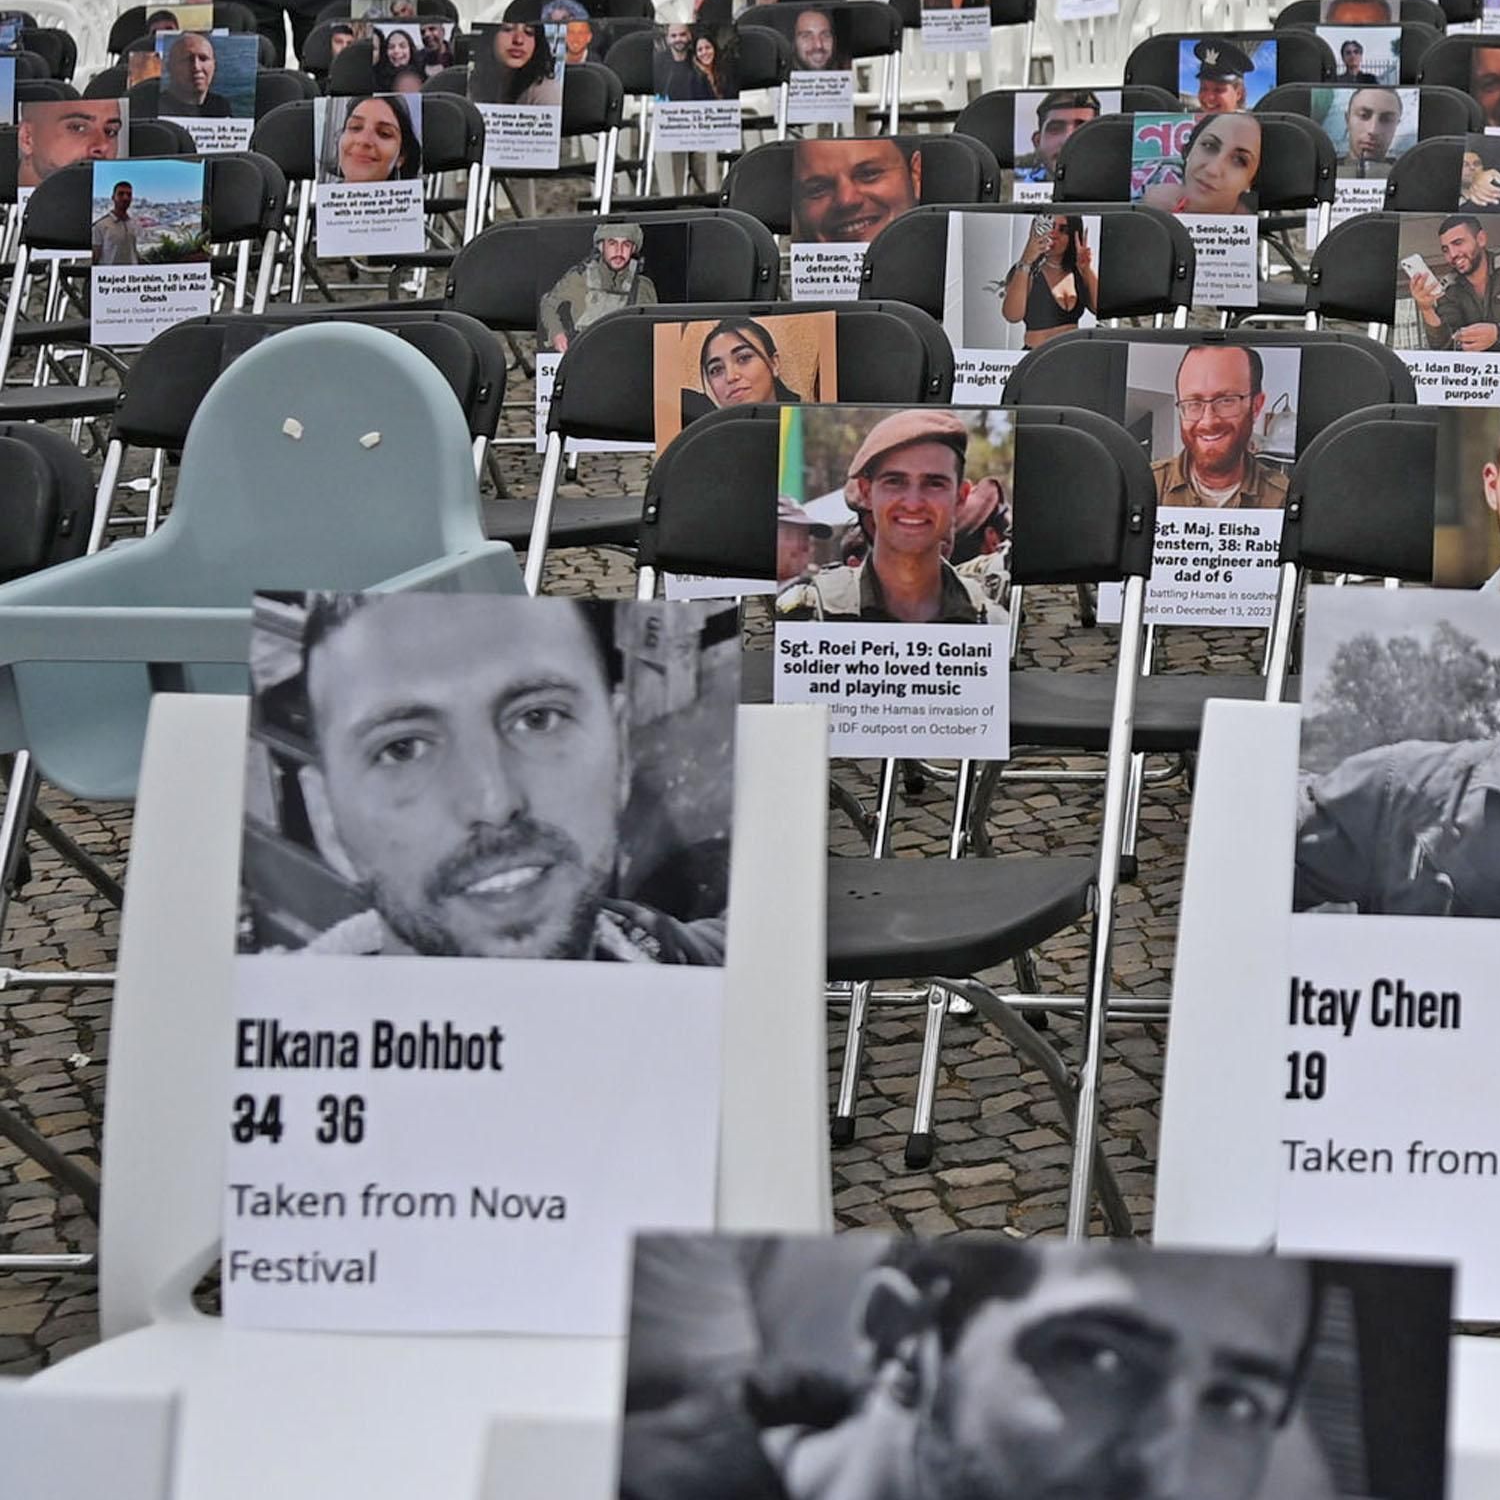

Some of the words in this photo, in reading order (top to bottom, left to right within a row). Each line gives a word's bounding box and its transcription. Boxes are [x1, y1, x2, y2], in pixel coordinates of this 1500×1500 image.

[1196, 224, 1230, 235] Senior,
[1218, 236, 1251, 247] helped
[793, 253, 815, 262] Aviv
[1206, 248, 1227, 256] rave
[806, 264, 852, 273] defender,
[98, 274, 126, 285] Majed
[128, 273, 165, 284] Ibrahim,
[183, 272, 206, 281] Killed
[795, 275, 830, 284] rockers
[833, 275, 840, 283] &
[99, 285, 109, 295] by
[112, 284, 141, 293] rocket
[144, 284, 162, 292] that
[163, 283, 176, 292] fell
[179, 283, 187, 291] in
[189, 282, 206, 291] Abu
[140, 294, 168, 303] Ghosh
[1425, 363, 1450, 373] Idan
[1453, 363, 1482, 376] Bloy,
[967, 374, 996, 387] night
[1441, 375, 1469, 387] lived
[1471, 378, 1478, 387] a
[1481, 376, 1499, 387] life
[1184, 522, 1214, 538] Maj.
[1218, 522, 1261, 536] Elisha
[1218, 539, 1241, 552] 38:
[1192, 553, 1253, 569] engineer
[1256, 554, 1281, 568] and
[1174, 570, 1201, 583] dad
[1205, 570, 1220, 583] of
[1223, 571, 1233, 583] 6
[1150, 587, 1188, 601] battling
[1190, 589, 1227, 600] Hamas
[1229, 589, 1238, 600] in
[1161, 605, 1174, 614] on
[1176, 604, 1228, 616] December
[1231, 604, 1245, 617] 13,
[1247, 606, 1273, 616] 2023
[780, 639, 814, 658] Sgt.
[818, 640, 856, 656] Roei
[861, 640, 899, 659] Peri,
[906, 641, 933, 657] 19:
[938, 642, 993, 659] Golani
[783, 660, 841, 675] soldier
[845, 660, 880, 676] who
[885, 661, 931, 677] loved
[936, 662, 989, 678] tennis
[809, 679, 841, 694] and
[846, 679, 906, 698] playing
[911, 682, 962, 697] music
[860, 703, 880, 716] the
[883, 704, 926, 717] Hamas
[929, 704, 980, 717] invasion
[982, 704, 995, 717] of
[838, 722, 859, 735] IDF
[862, 723, 908, 737] outpost
[911, 725, 927, 735] on
[930, 723, 977, 736] October
[980, 723, 988, 736] 7
[1289, 976, 1360, 1037] Itay
[1371, 980, 1461, 1029] Chen
[236, 1017, 358, 1070] Elkana
[371, 1019, 504, 1072] Bohbot
[1285, 1052, 1326, 1101] 19
[233, 1095, 283, 1144] 34
[316, 1094, 365, 1145] 36
[1283, 1140, 1393, 1174] Taken
[1406, 1141, 1498, 1177] from
[230, 1185, 345, 1219] Taken
[359, 1184, 456, 1220] from
[471, 1187, 566, 1222] Nova
[229, 1250, 377, 1284] Festival
